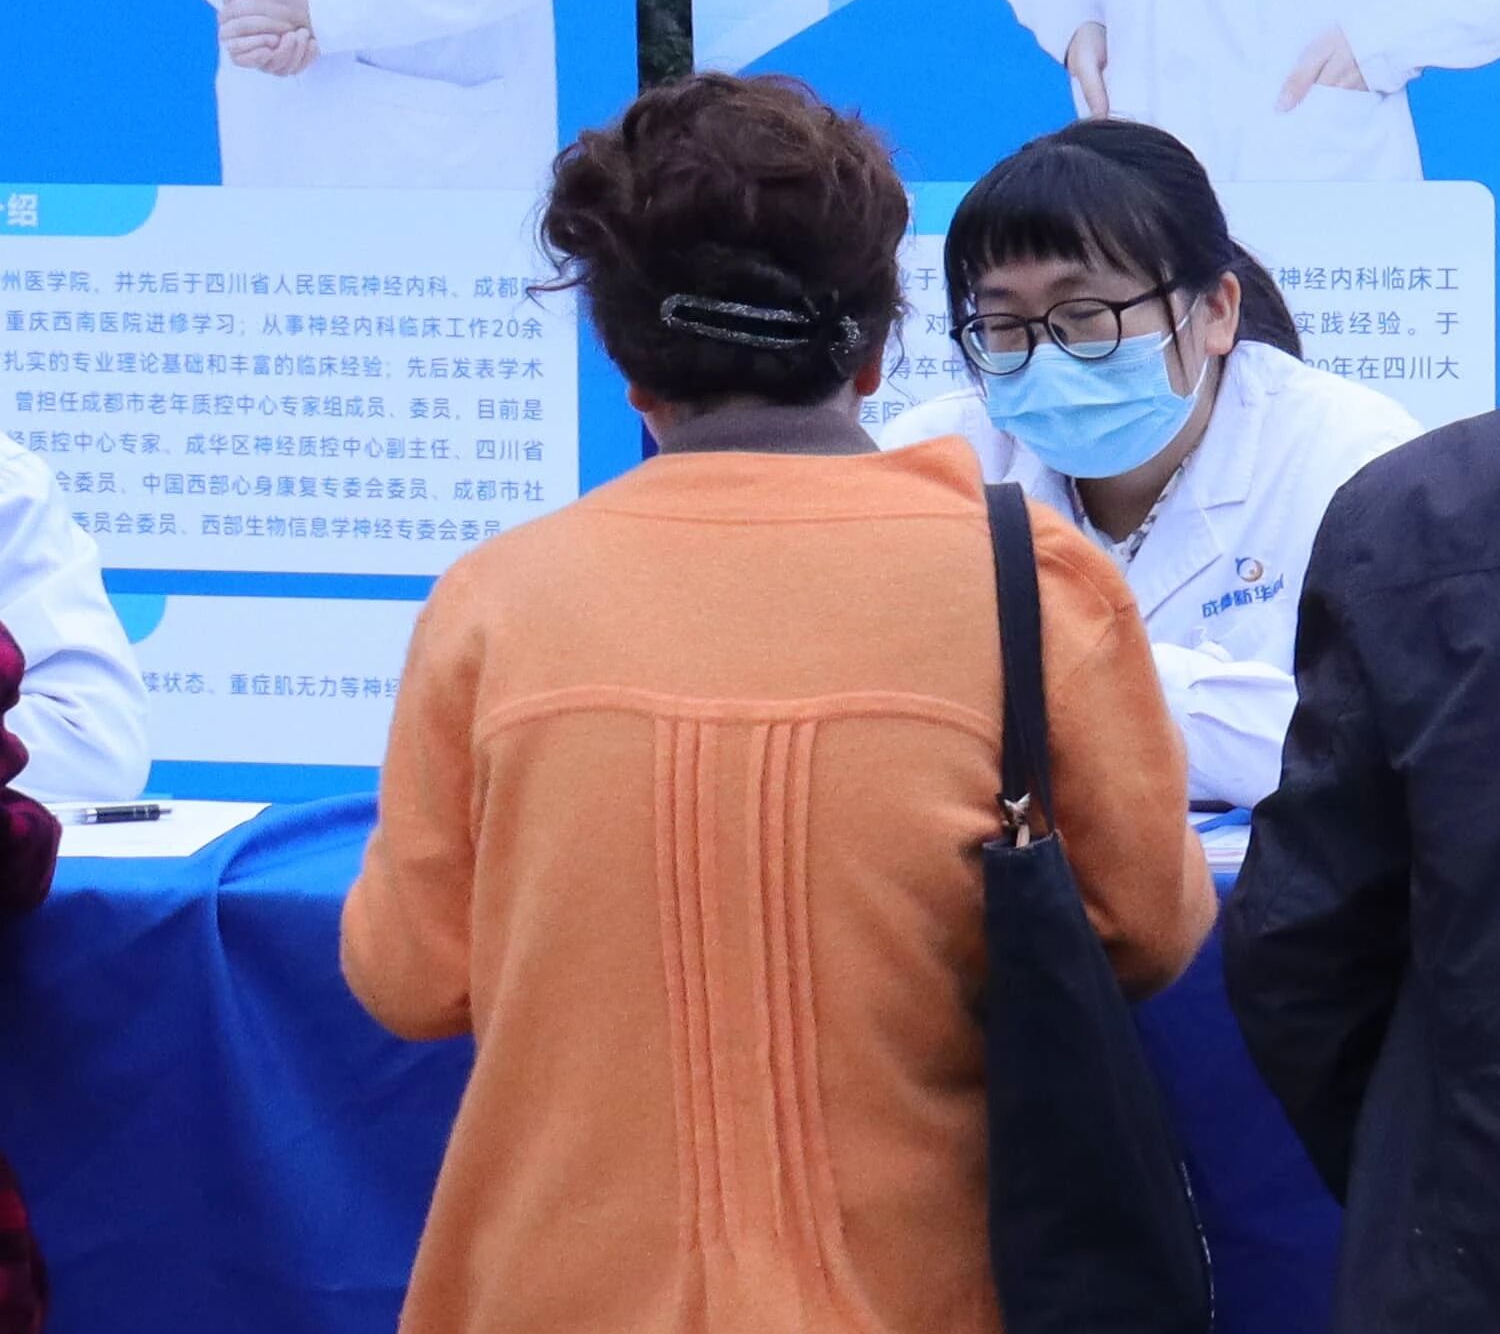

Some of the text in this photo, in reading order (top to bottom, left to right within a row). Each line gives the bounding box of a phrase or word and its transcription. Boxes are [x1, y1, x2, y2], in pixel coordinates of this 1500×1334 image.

[0, 192, 38, 228] 绍
[1271, 267, 1459, 291] 神经内科临床工
